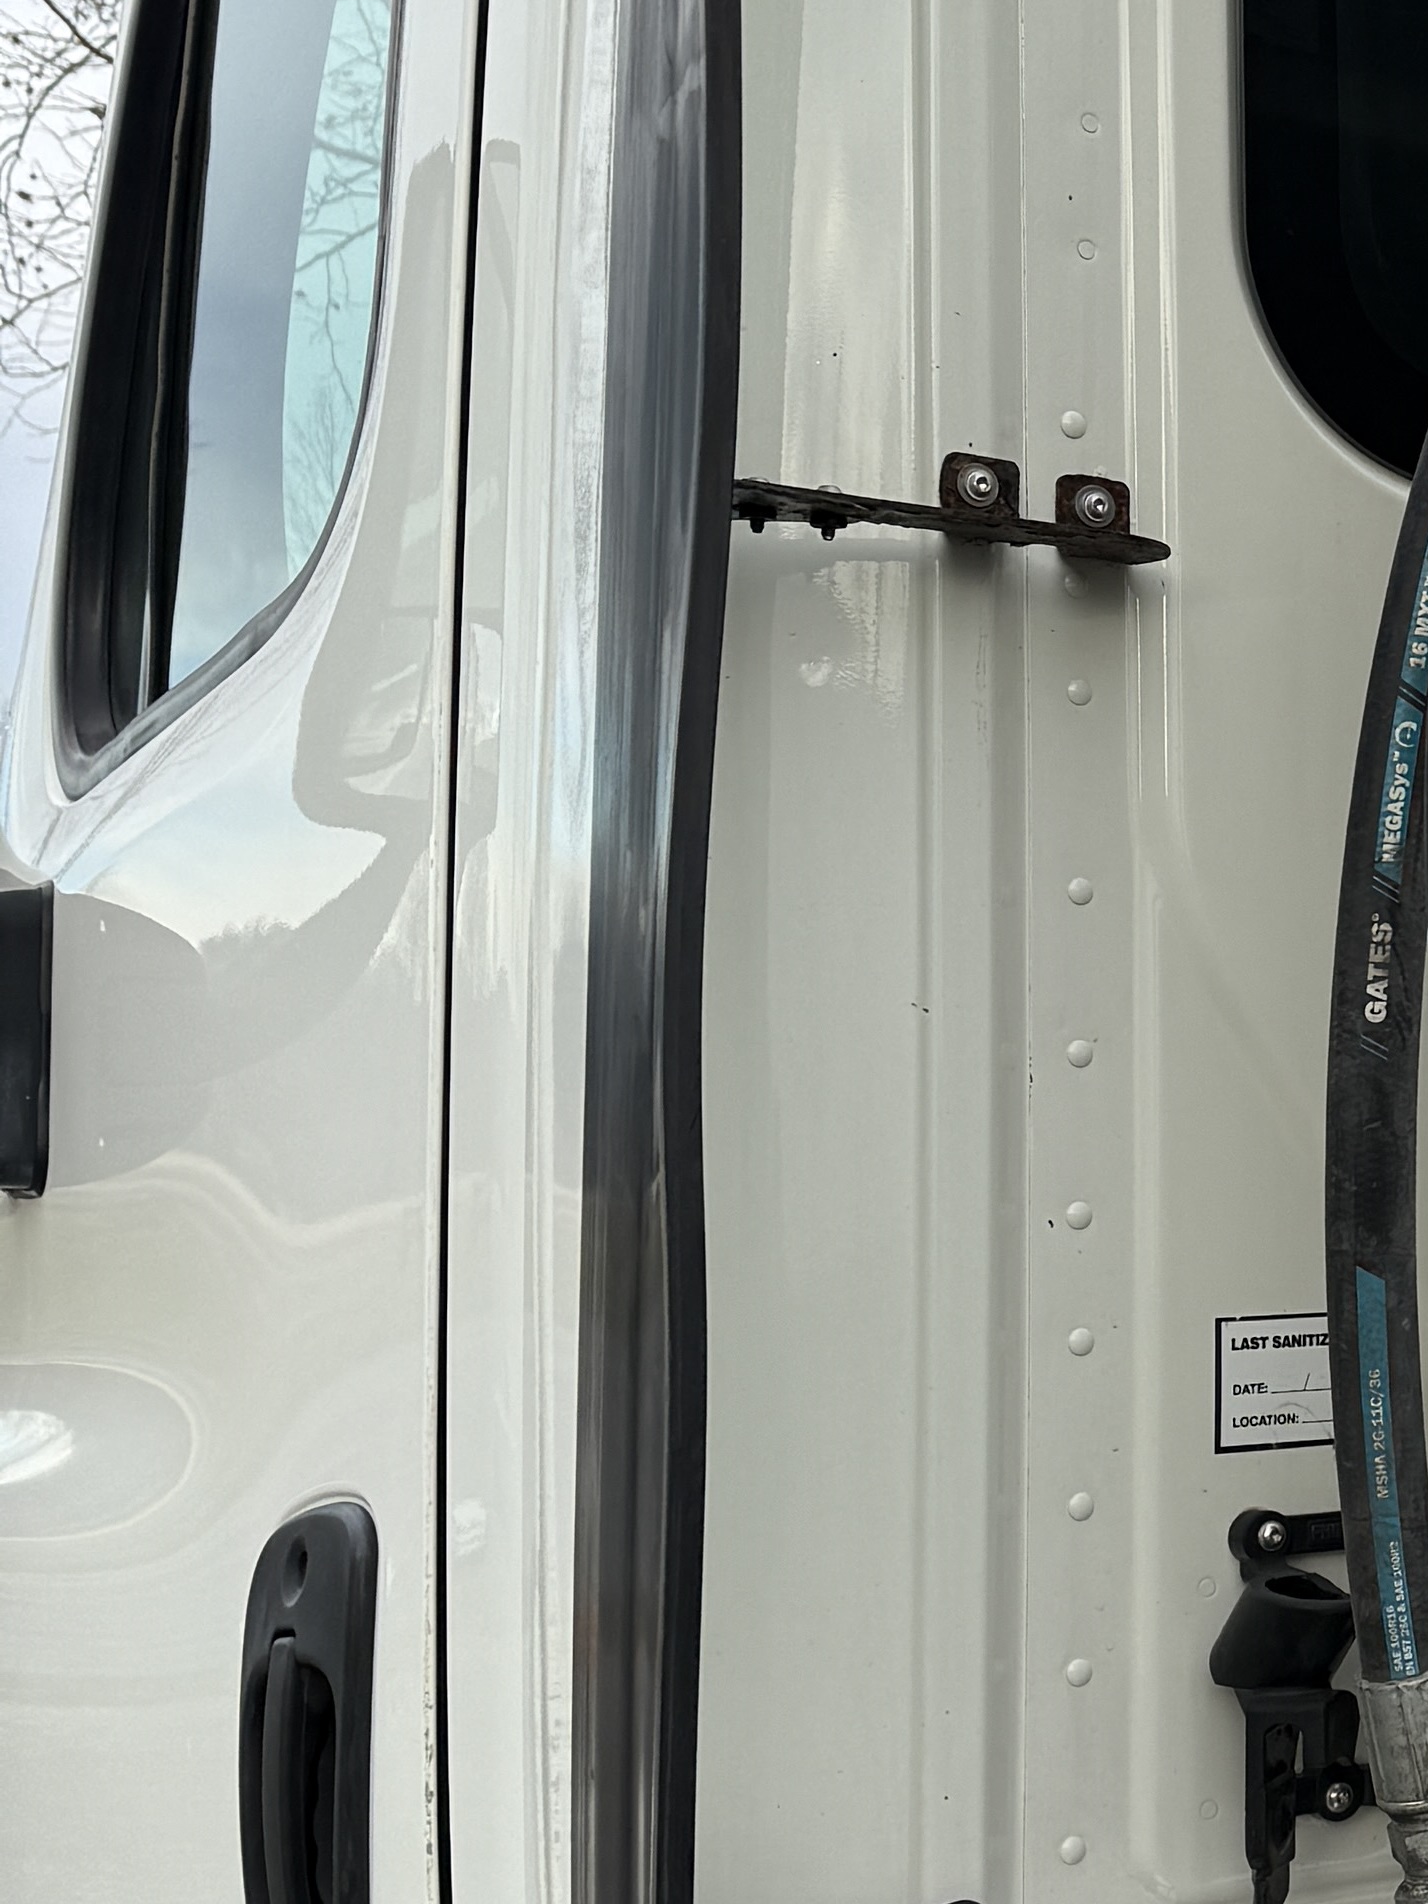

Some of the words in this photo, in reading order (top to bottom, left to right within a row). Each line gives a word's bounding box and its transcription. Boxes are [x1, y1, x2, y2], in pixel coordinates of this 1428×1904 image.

[1409, 642, 1428, 670] 16
[1231, 1337, 1269, 1351] LAST
[1272, 1333, 1329, 1348] SANITIZ
[1233, 1383, 1268, 1396] DATE:
[1232, 1413, 1299, 1428] LOCATION:
[1375, 1454, 1389, 1499] MSHA
